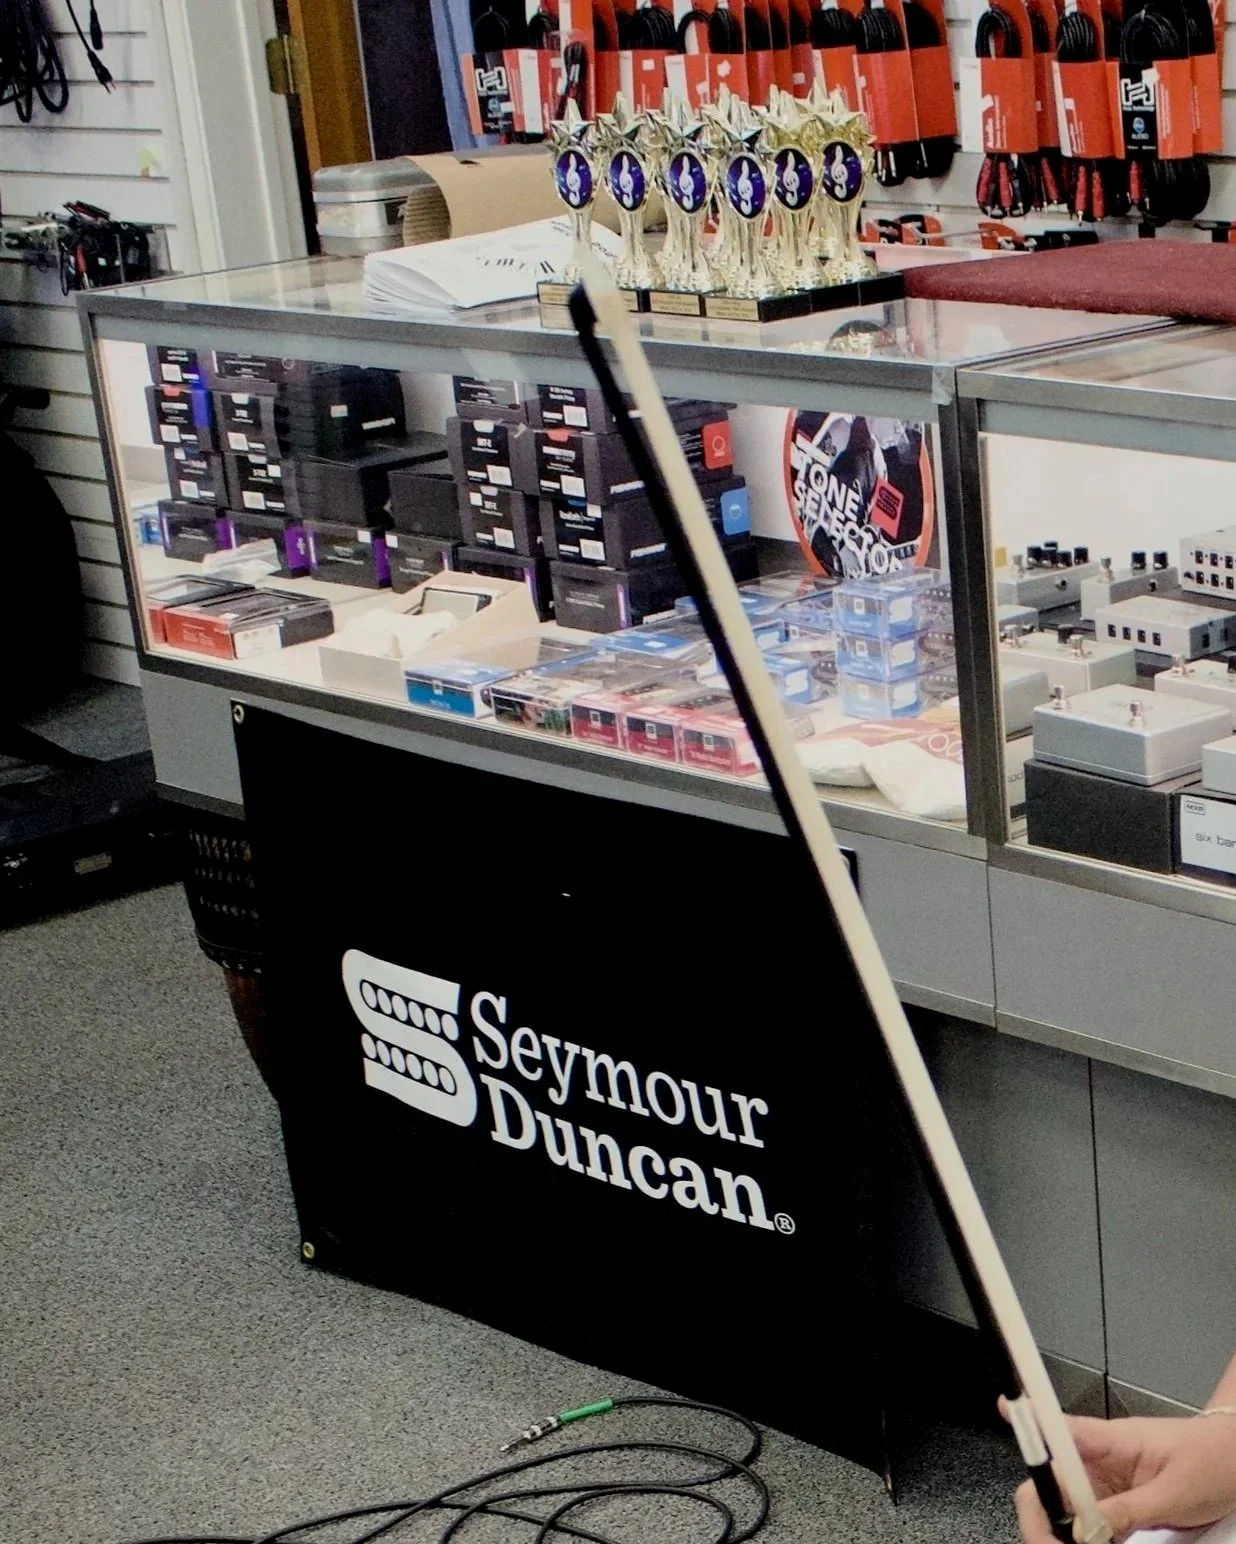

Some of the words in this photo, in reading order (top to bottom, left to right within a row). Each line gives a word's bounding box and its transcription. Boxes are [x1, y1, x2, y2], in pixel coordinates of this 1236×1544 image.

[791, 443, 861, 522] TONE
[1195, 831, 1212, 844] six
[471, 991, 768, 1149] Seymour
